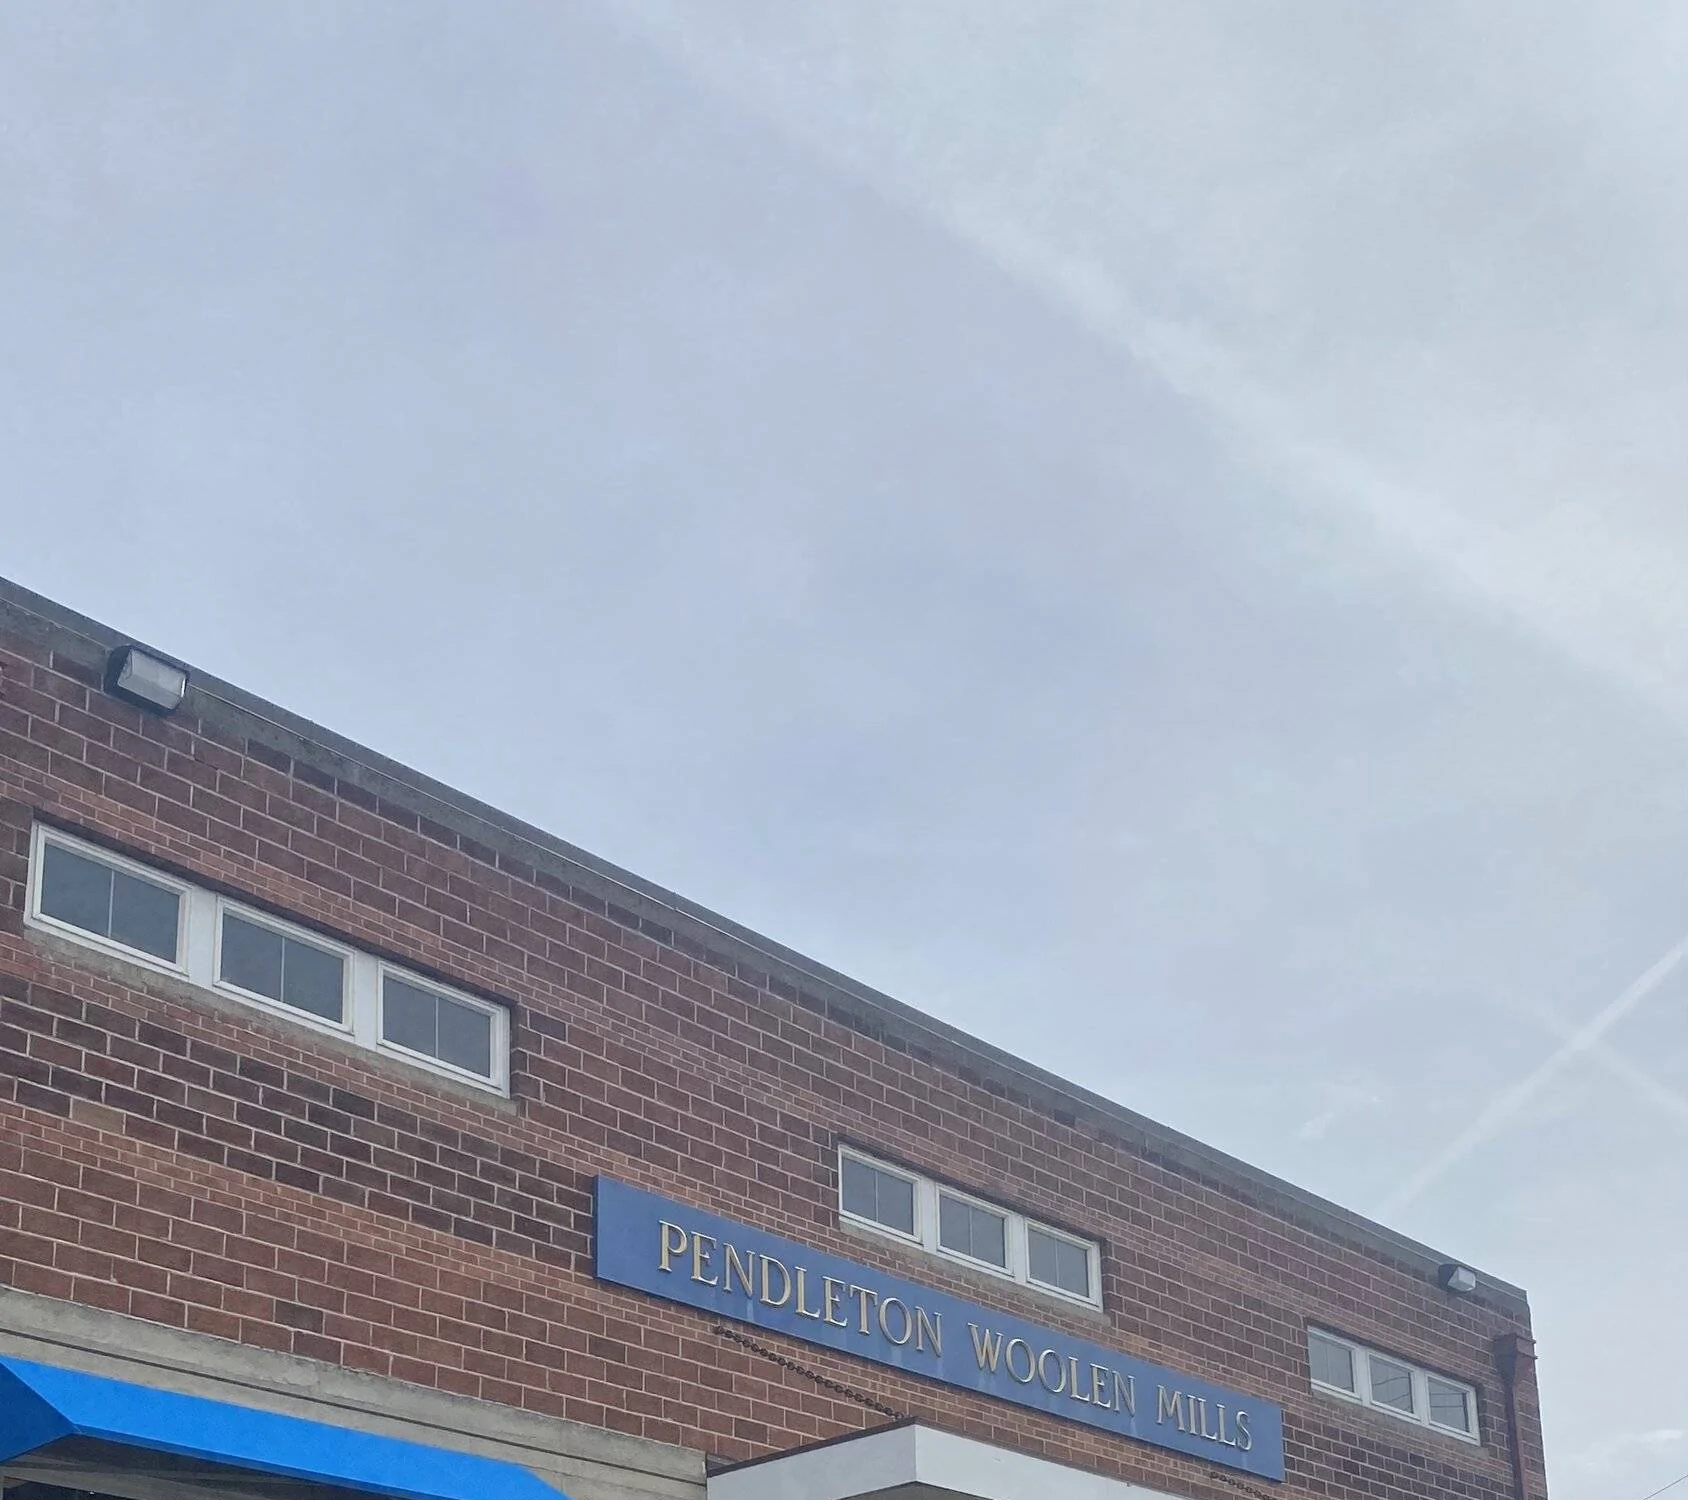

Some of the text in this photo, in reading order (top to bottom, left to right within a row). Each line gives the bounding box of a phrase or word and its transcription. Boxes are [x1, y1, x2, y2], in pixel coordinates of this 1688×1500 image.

[657, 1219, 1253, 1452] PENDLETON WOOLEN MILLS
